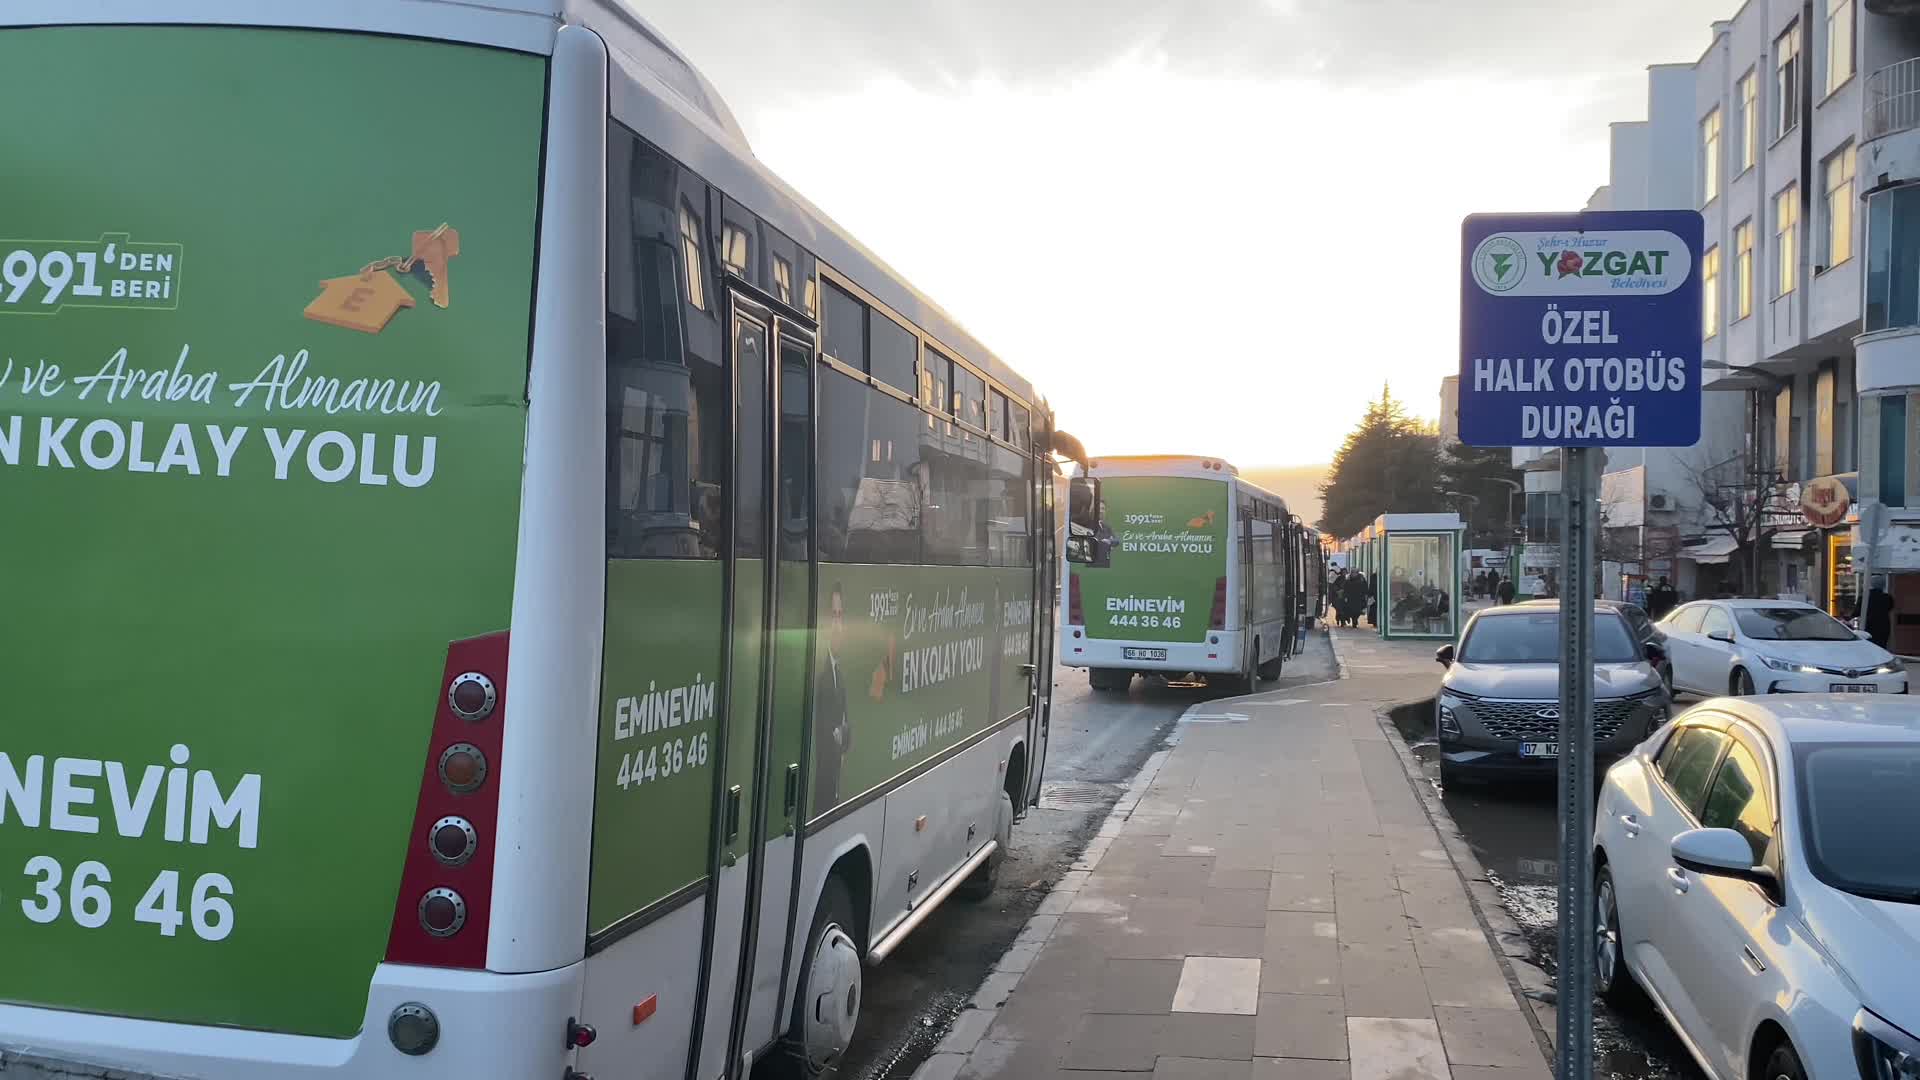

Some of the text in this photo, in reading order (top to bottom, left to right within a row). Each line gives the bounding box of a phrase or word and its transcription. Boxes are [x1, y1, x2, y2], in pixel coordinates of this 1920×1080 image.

[110, 275, 171, 299] BERİ
[1541, 303, 1619, 345] ÖZEL
[21, 358, 67, 397] ve
[73, 343, 218, 404] Araba
[229, 348, 443, 417] Almanın
[1474, 350, 1686, 392] HALK OTOBÜS
[1521, 397, 1636, 439] DURAĞI
[37, 416, 249, 477] KOLAY
[263, 426, 438, 488] YOLU
[1122, 542, 1213, 554] EN KOLAY YOLU
[1106, 594, 1185, 613] EMİNEVİM
[1109, 614, 1181, 629] 444 36 46
[902, 635, 985, 693] EN KOLAY YOLU
[614, 671, 715, 742] EMİNEVİM
[616, 731, 708, 790] 444 36 46
[1524, 743, 1537, 754] 07
[0, 743, 262, 849] NEVİM
[21, 855, 236, 941] 36 46
